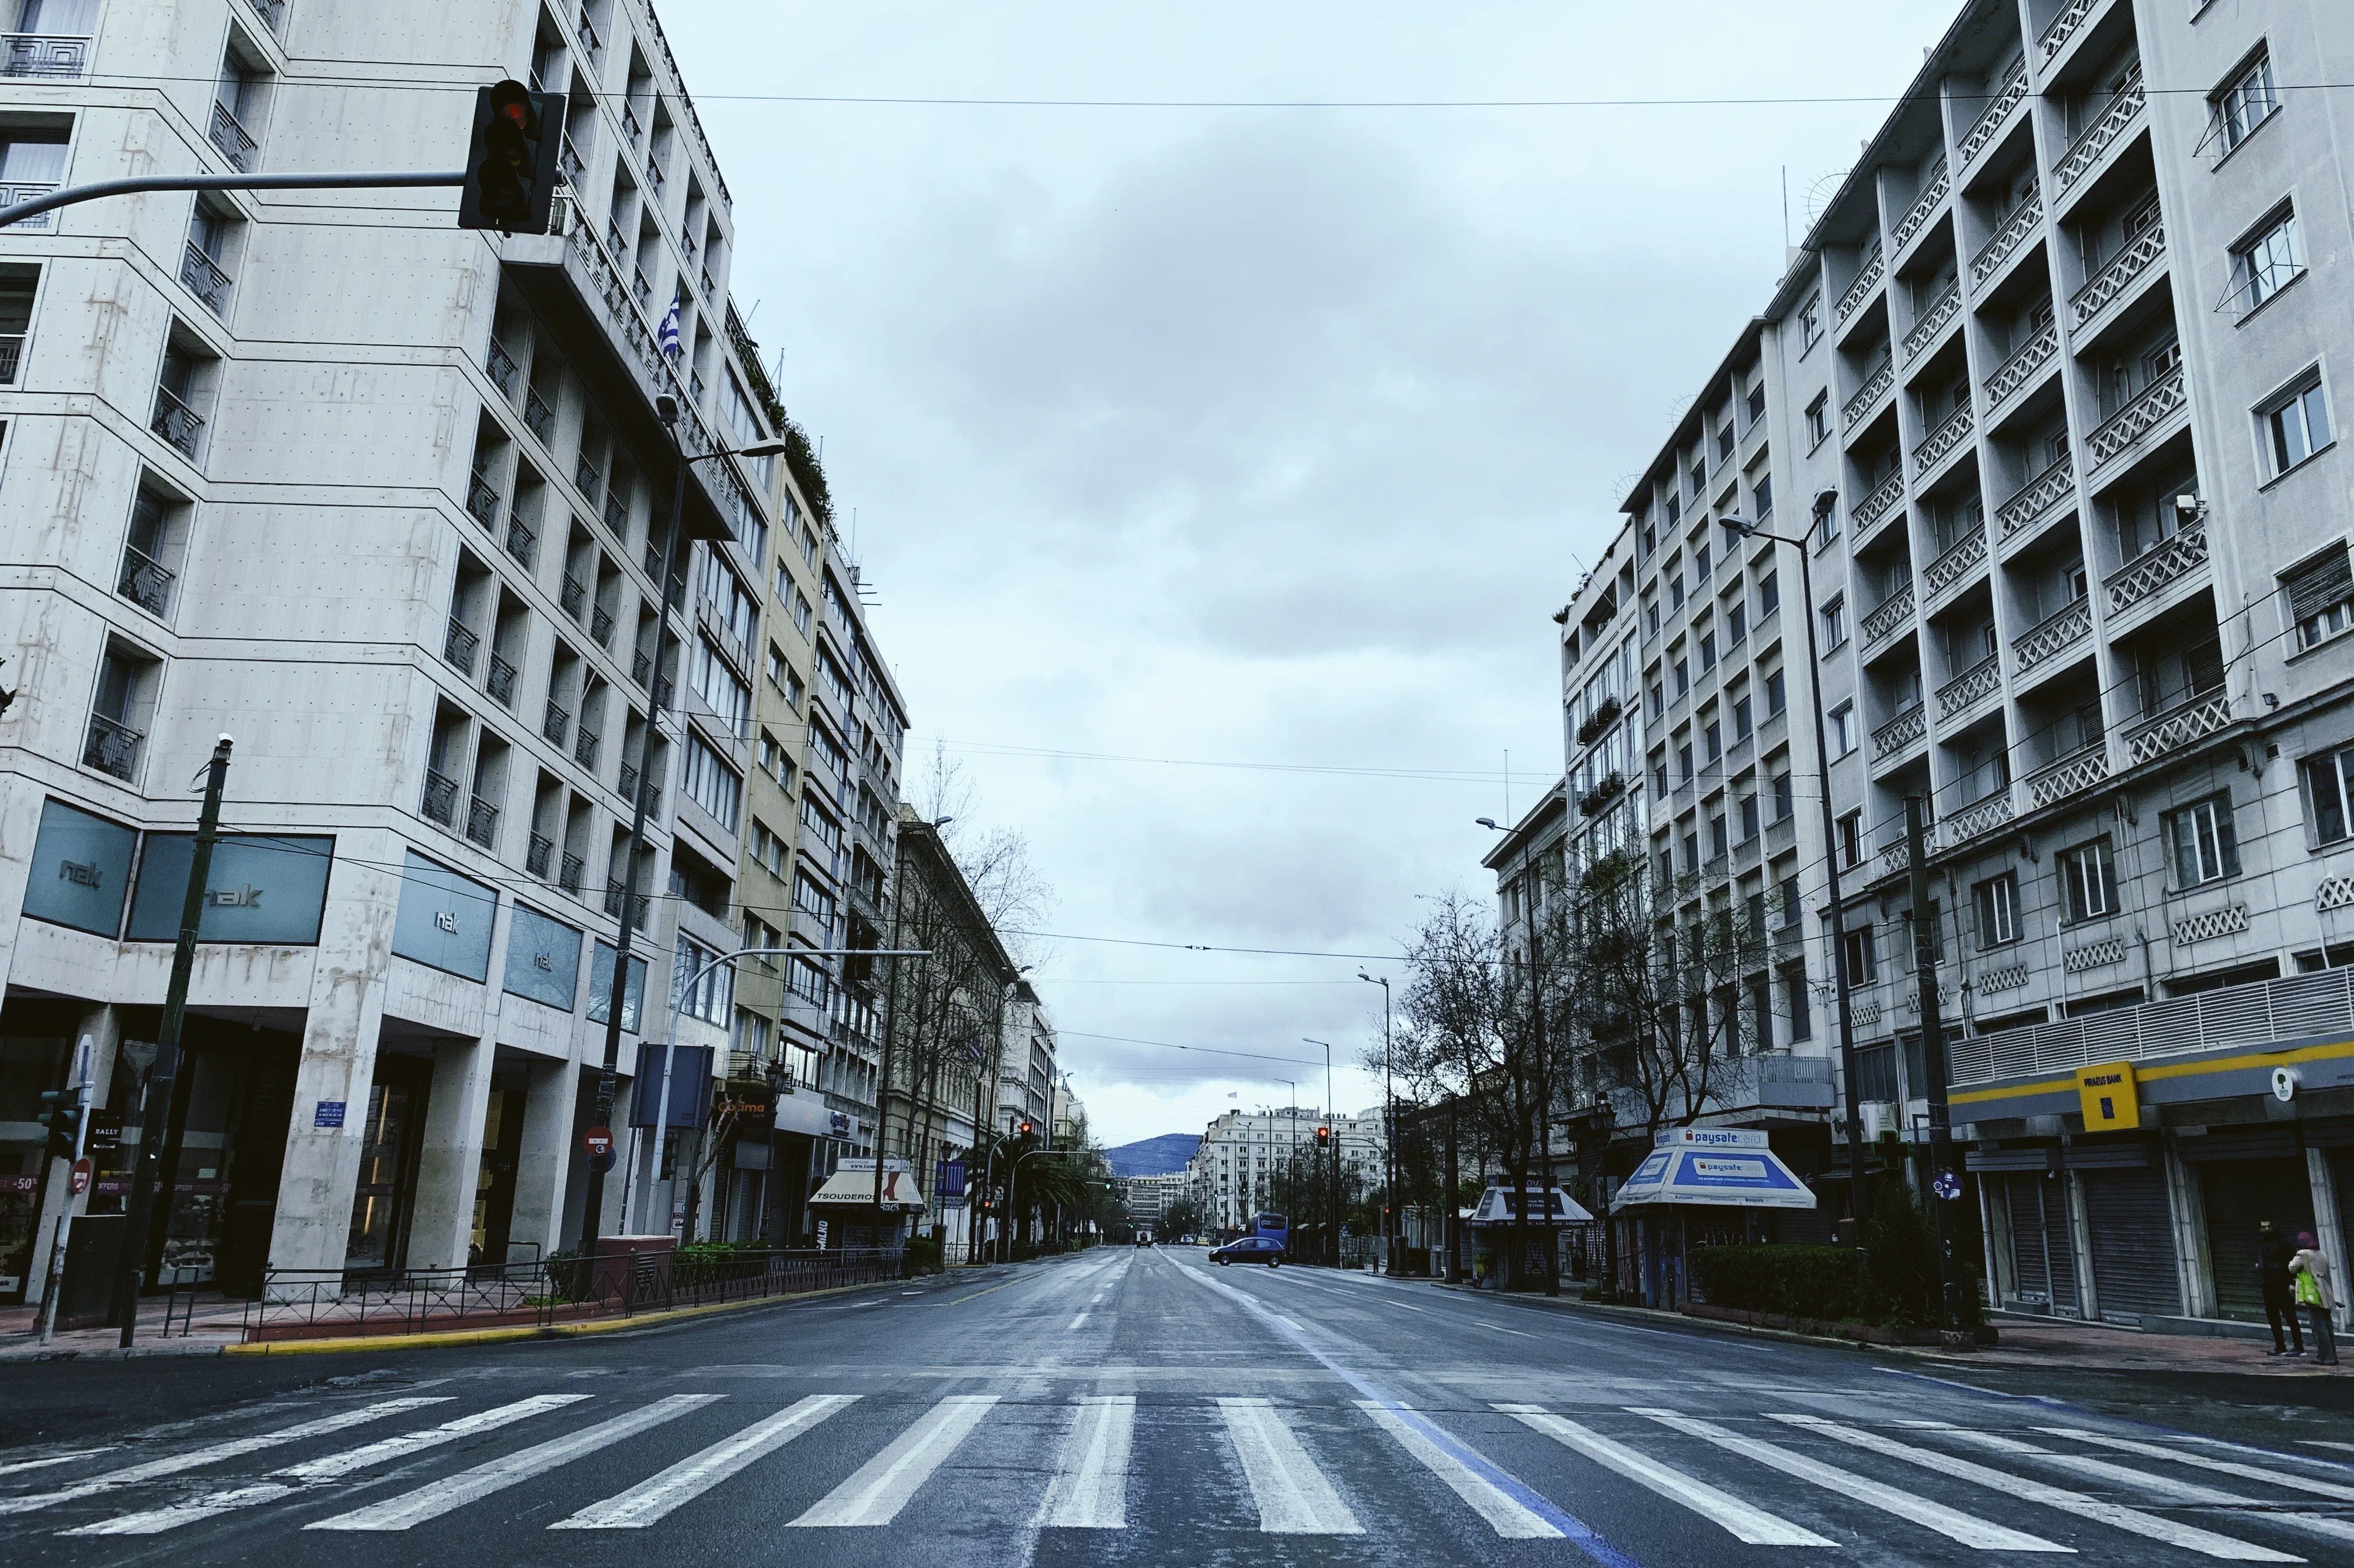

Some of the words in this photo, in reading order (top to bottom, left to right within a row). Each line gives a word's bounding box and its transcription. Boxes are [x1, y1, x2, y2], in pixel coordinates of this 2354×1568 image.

[59, 860, 103, 890] nak
[434, 912, 460, 935] nak
[2084, 1076, 2106, 1087] PIRAEUS
[2106, 1074, 2122, 1085] BANK
